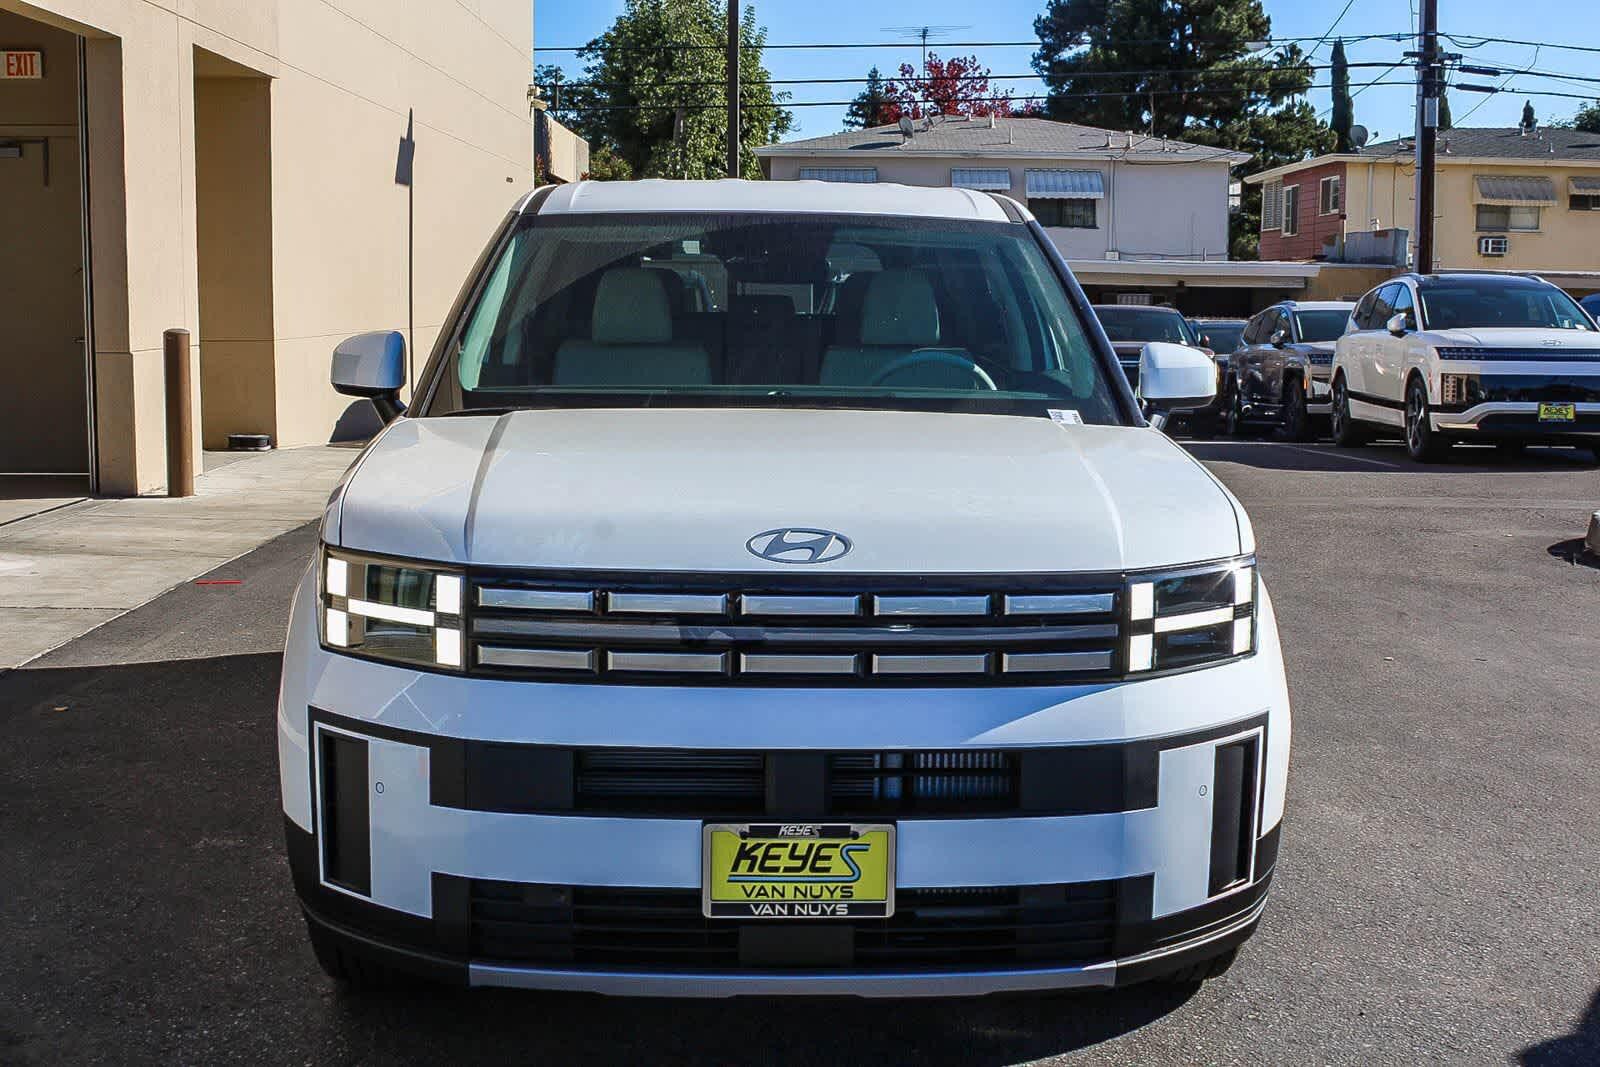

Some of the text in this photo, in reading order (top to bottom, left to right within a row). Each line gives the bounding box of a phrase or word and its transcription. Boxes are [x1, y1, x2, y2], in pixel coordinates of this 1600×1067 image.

[7, 53, 35, 76] EXIT
[778, 825, 822, 838] KEYES
[728, 842, 871, 883] KEYES
[741, 885, 854, 898] VAN NUYS
[750, 903, 849, 915] VAN NUYS
